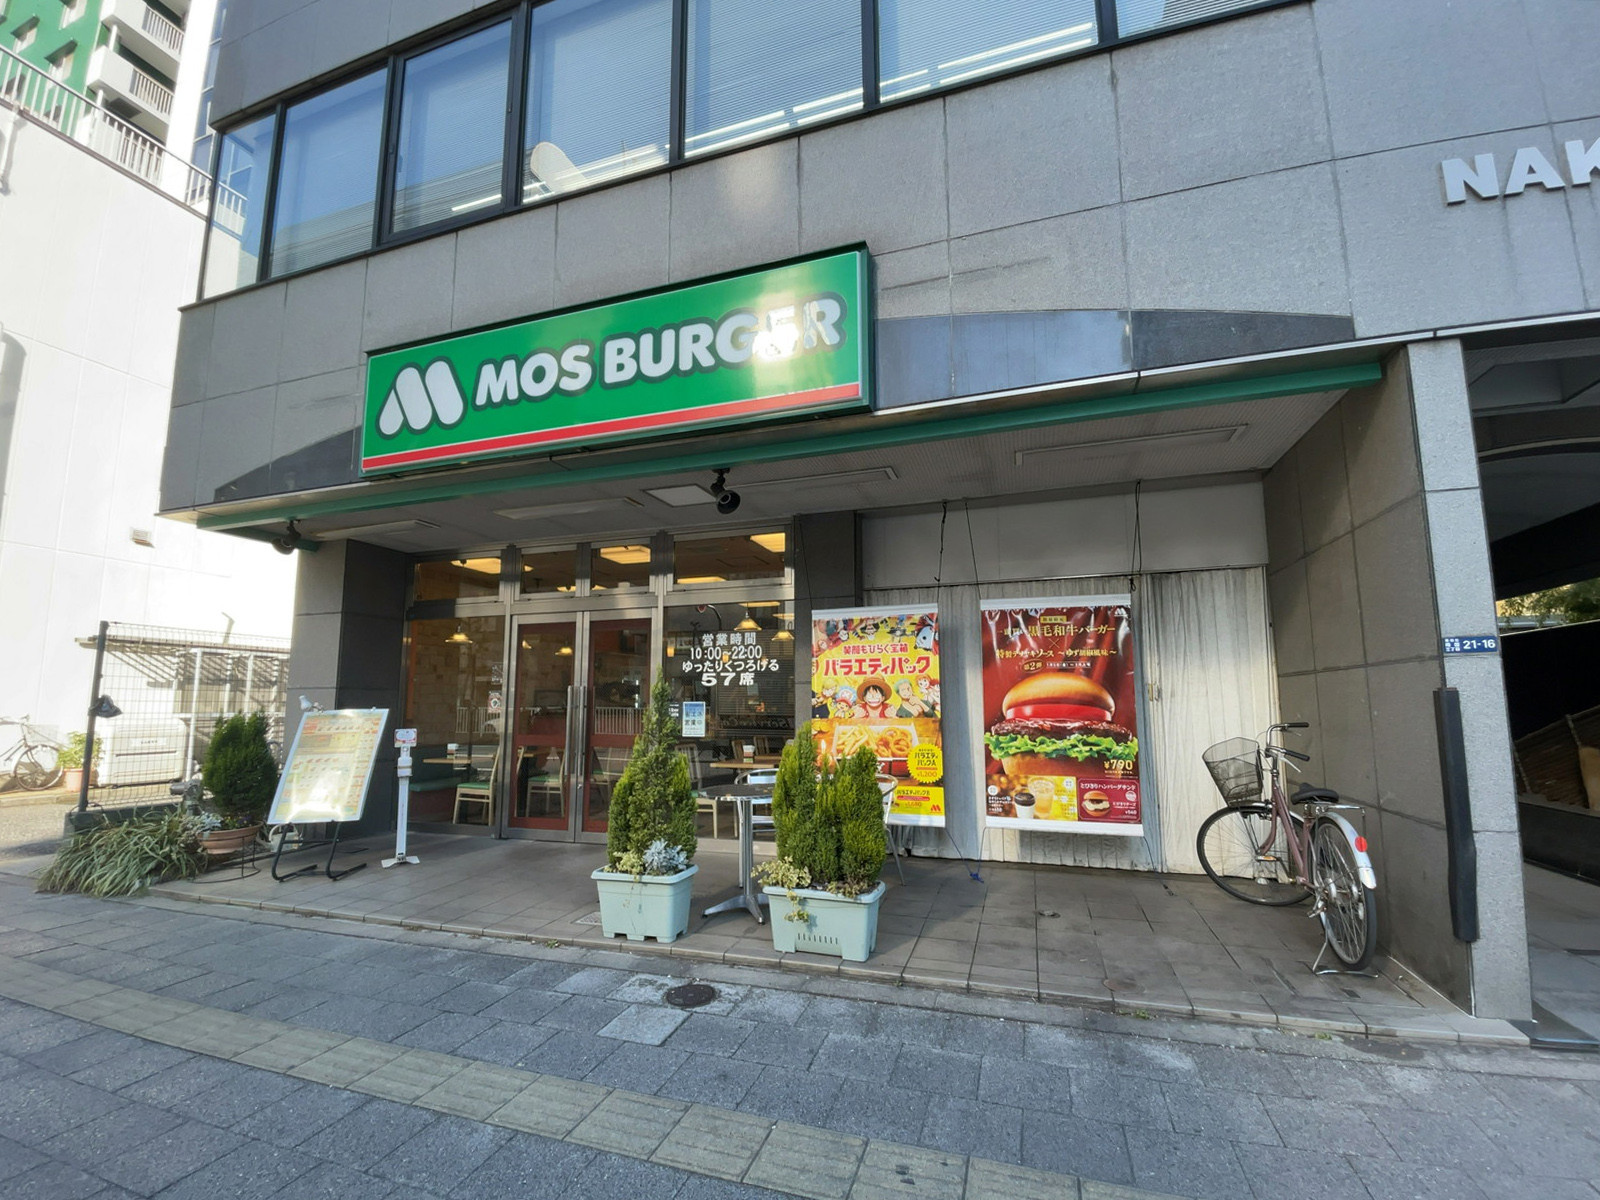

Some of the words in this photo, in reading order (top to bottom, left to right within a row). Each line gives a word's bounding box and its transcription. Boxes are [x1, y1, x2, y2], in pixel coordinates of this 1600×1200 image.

[474, 341, 595, 409] MOS
[602, 294, 845, 387] BURGER
[702, 632, 757, 647] 営業時間
[1462, 639, 1496, 650] 21-16
[682, 659, 780, 673] ゆったりくつろげる
[824, 656, 931, 677] バラエティパック
[701, 672, 755, 686] 57席
[1103, 759, 1134, 770] ¥790
